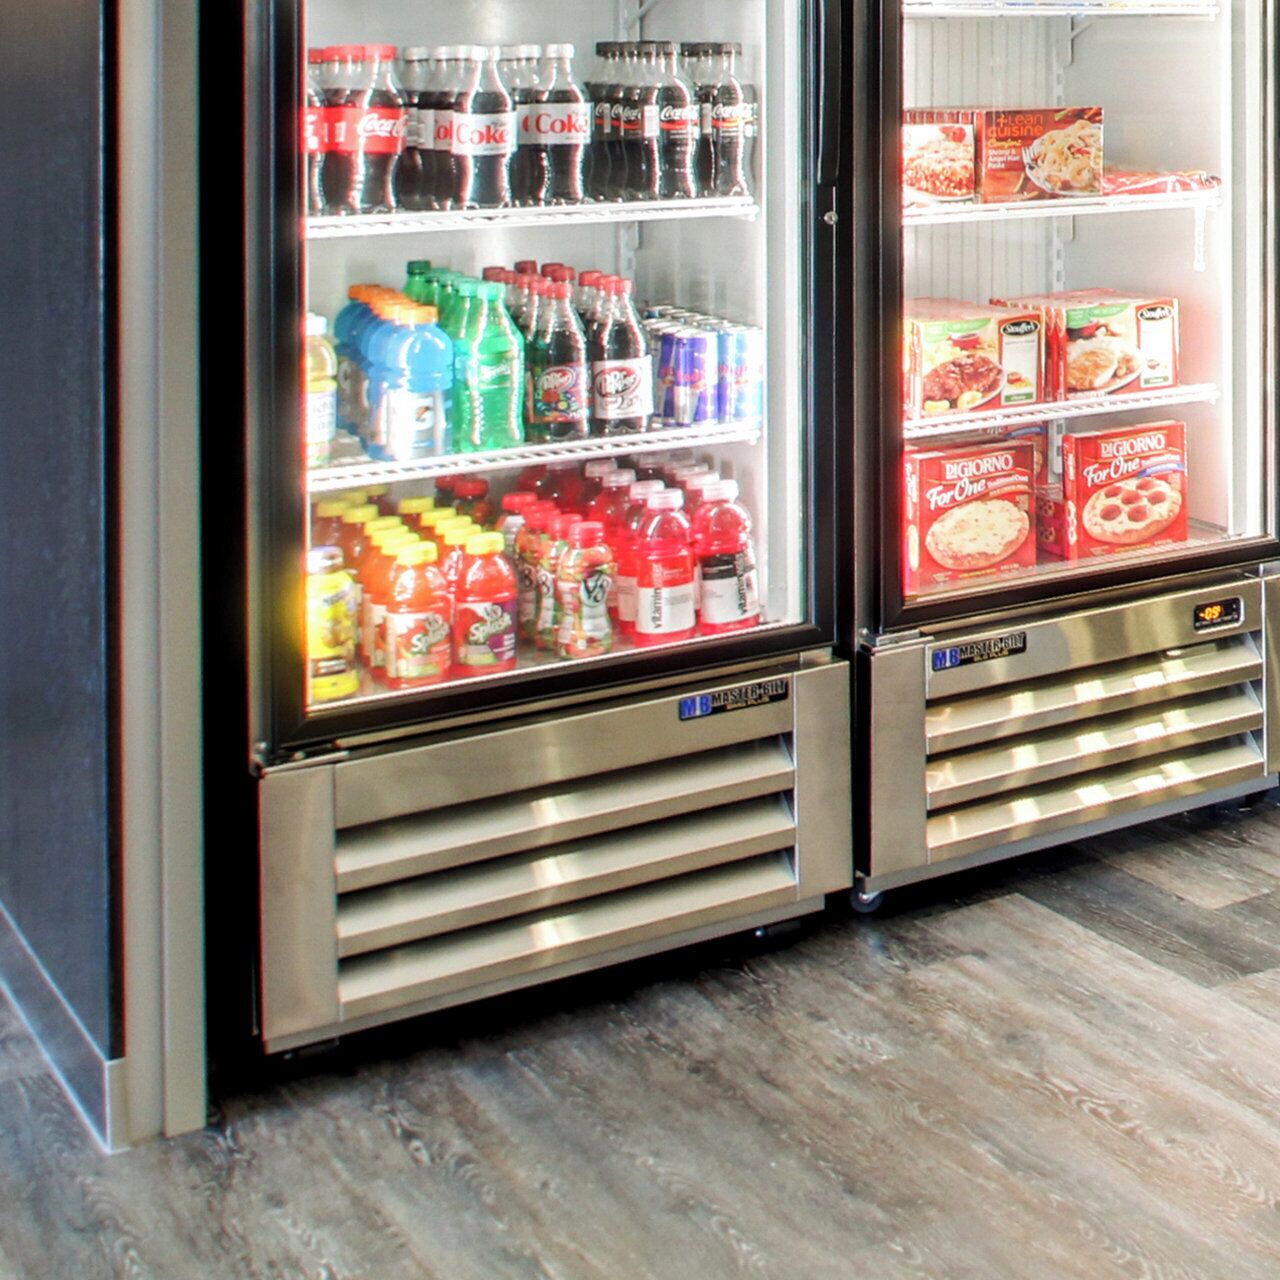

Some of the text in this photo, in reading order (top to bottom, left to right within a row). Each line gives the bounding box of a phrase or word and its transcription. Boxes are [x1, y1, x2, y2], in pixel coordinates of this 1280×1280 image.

[455, 118, 510, 144] Coke
[535, 113, 589, 135] Coke
[1101, 434, 1165, 458] DIGIORNO
[945, 454, 1014, 480] DIGIORNO
[1083, 456, 1140, 488] For One
[926, 477, 986, 510] For One
[582, 574, 612, 603] V8
